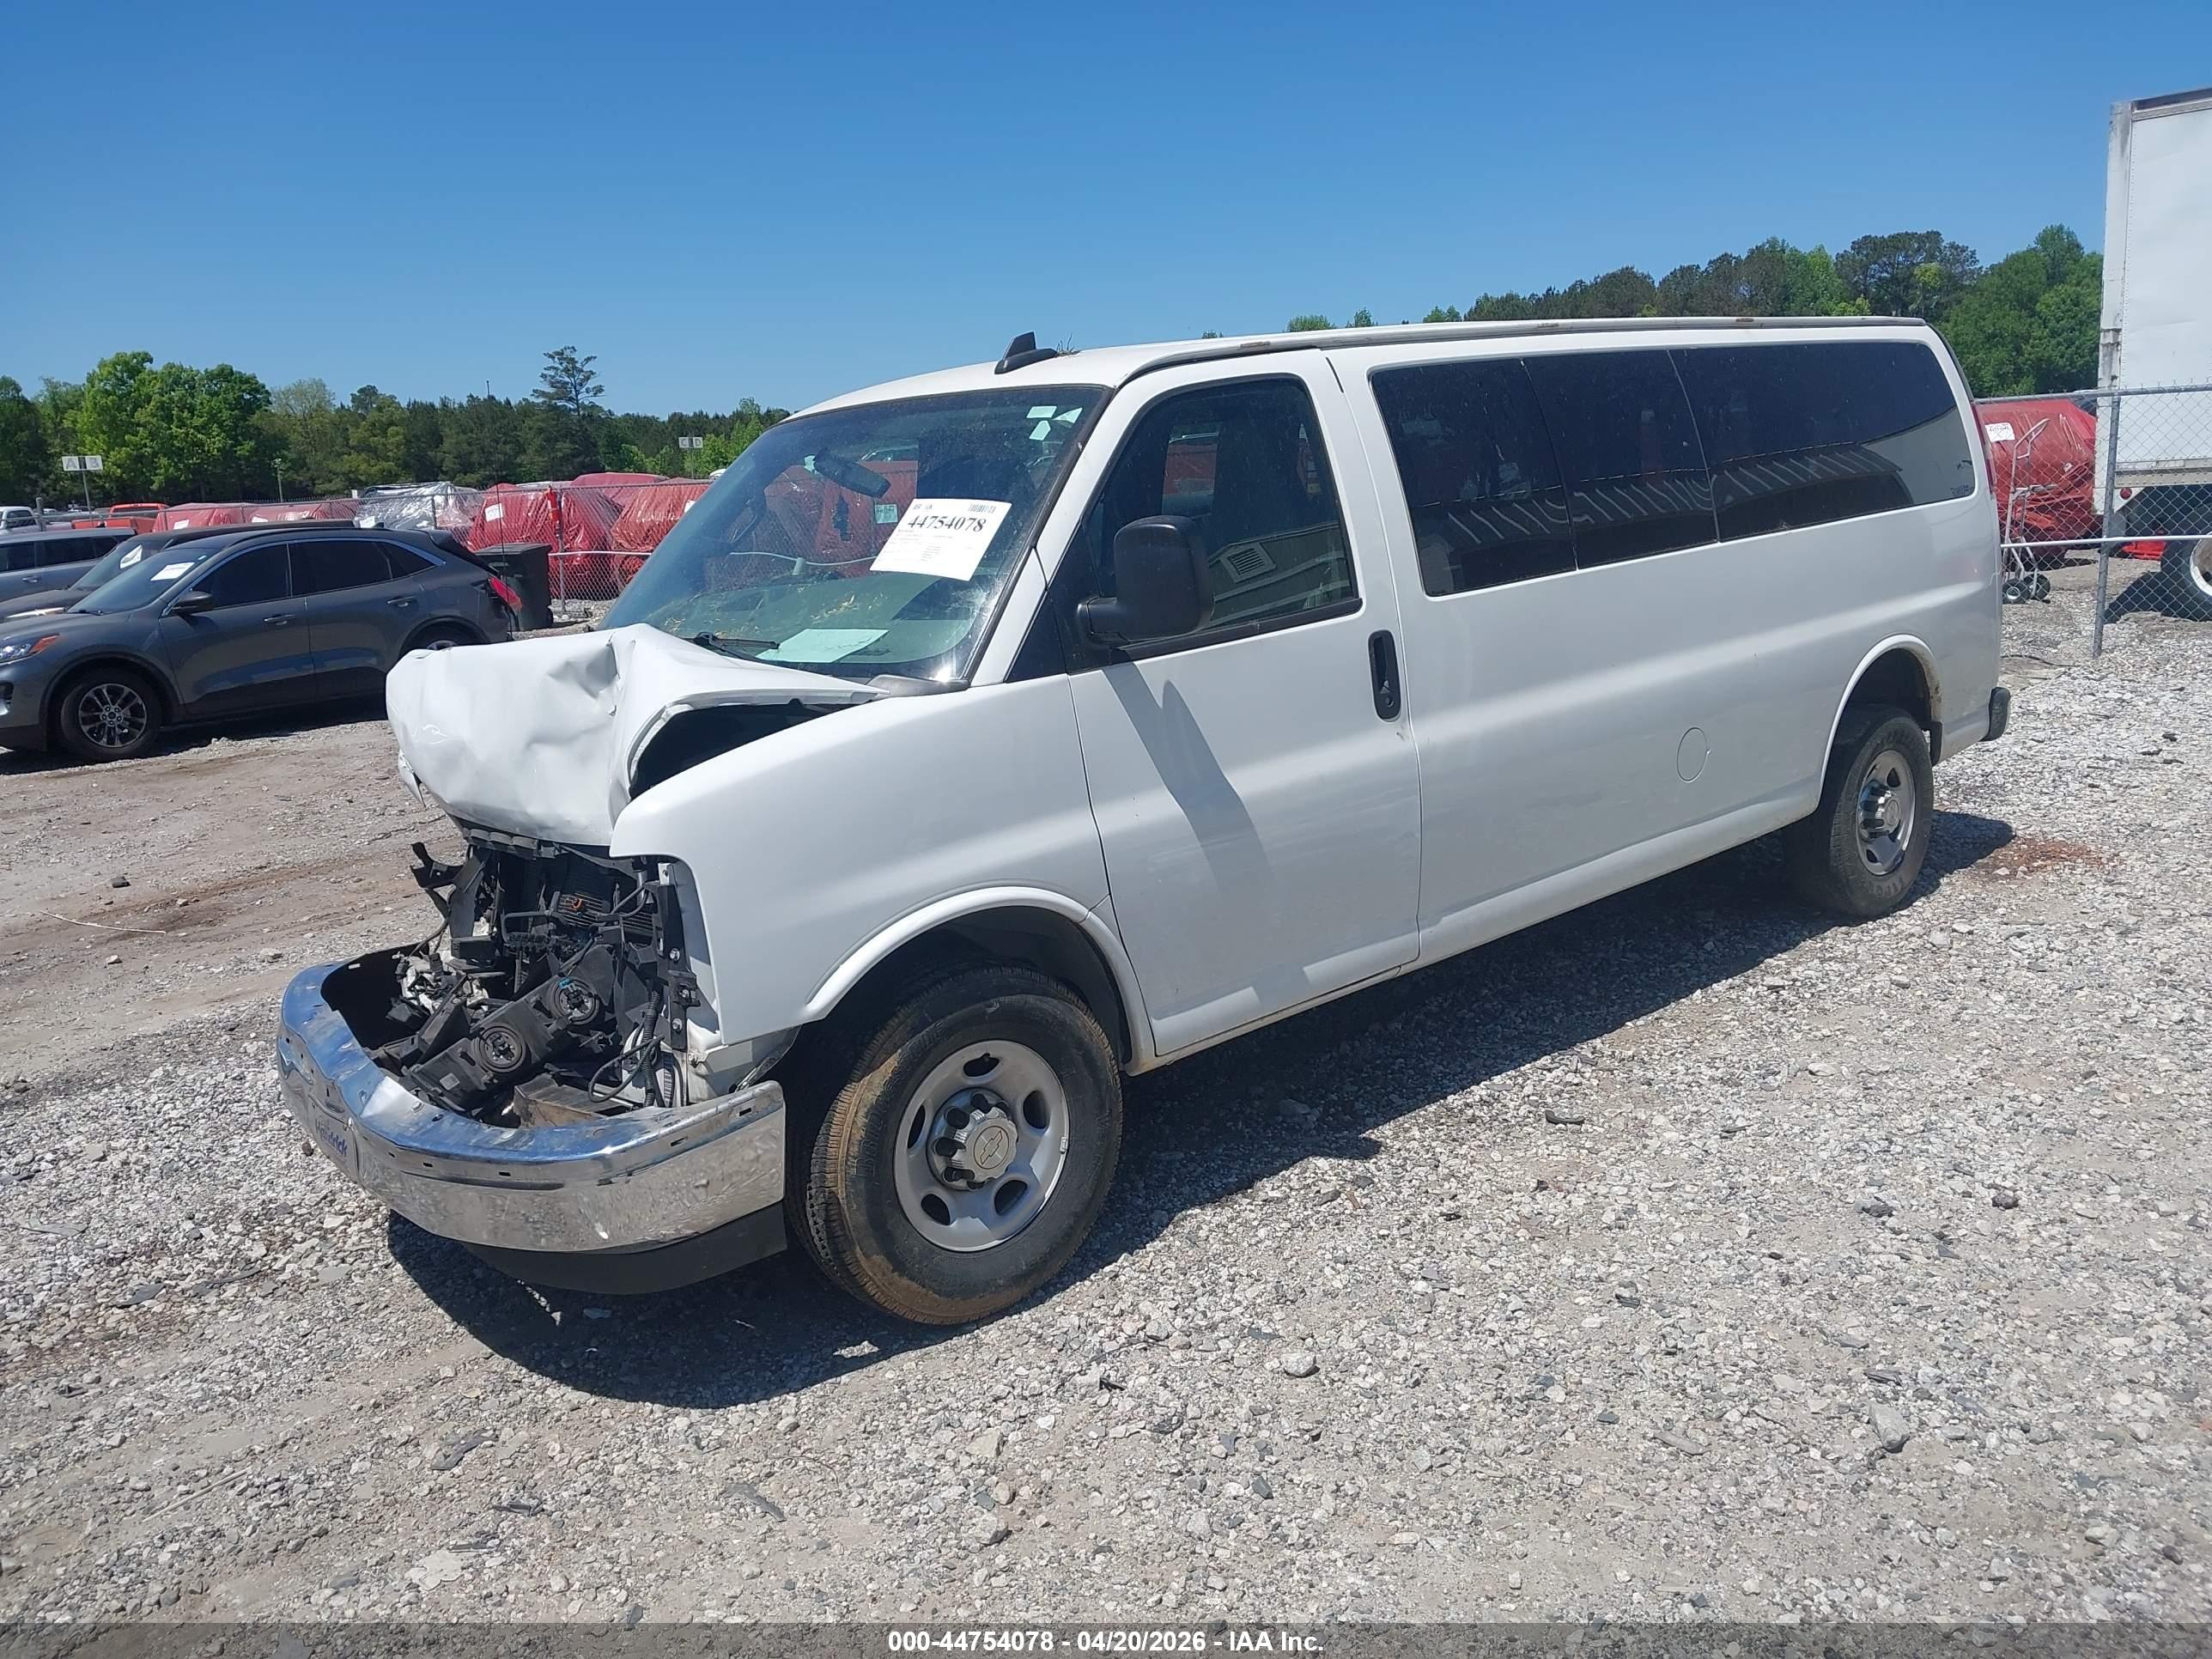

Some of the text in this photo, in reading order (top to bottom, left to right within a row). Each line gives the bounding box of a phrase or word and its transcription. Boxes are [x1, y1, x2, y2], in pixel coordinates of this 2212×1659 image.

[65, 457, 100, 469] A B
[908, 515, 987, 532] 44754078
